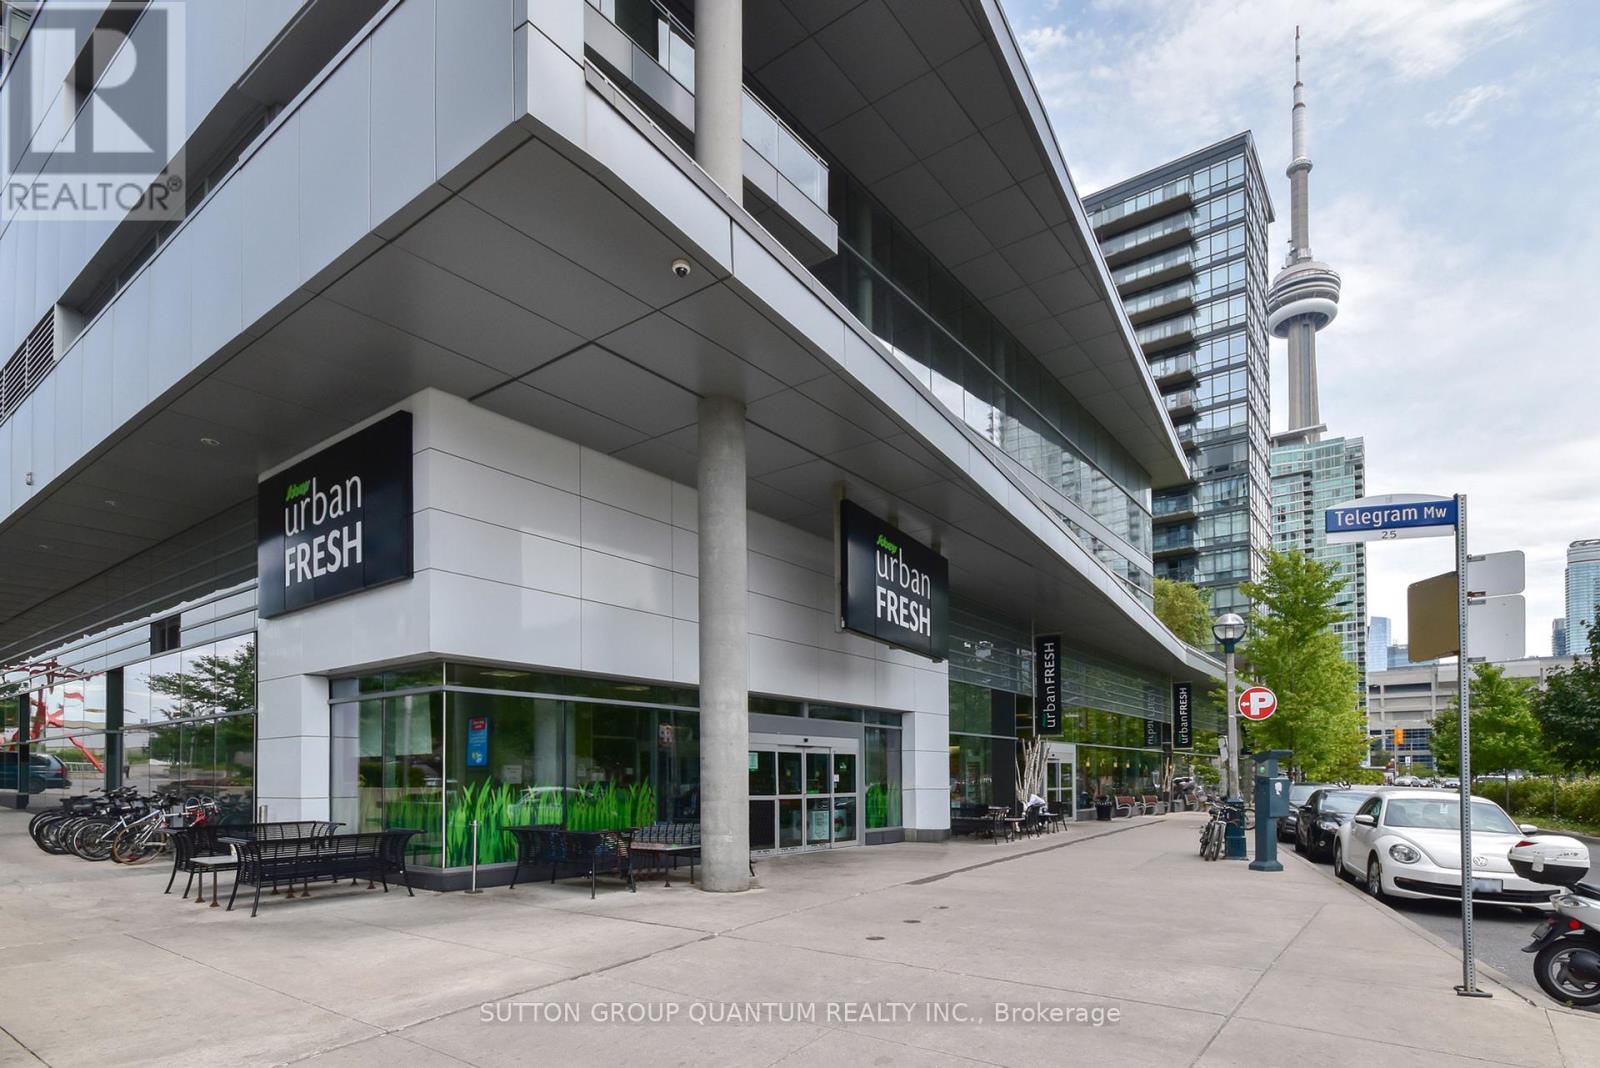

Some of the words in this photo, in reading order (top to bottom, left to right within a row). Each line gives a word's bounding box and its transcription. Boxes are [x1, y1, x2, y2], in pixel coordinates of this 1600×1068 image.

[285, 475, 362, 537] urban
[1335, 507, 1418, 527] Telegram
[1423, 506, 1447, 519] Mw
[285, 520, 362, 587] FRESH
[1381, 530, 1397, 540] 25
[876, 547, 931, 600] urban
[876, 585, 931, 636] FRESH
[1250, 691, 1275, 716] P
